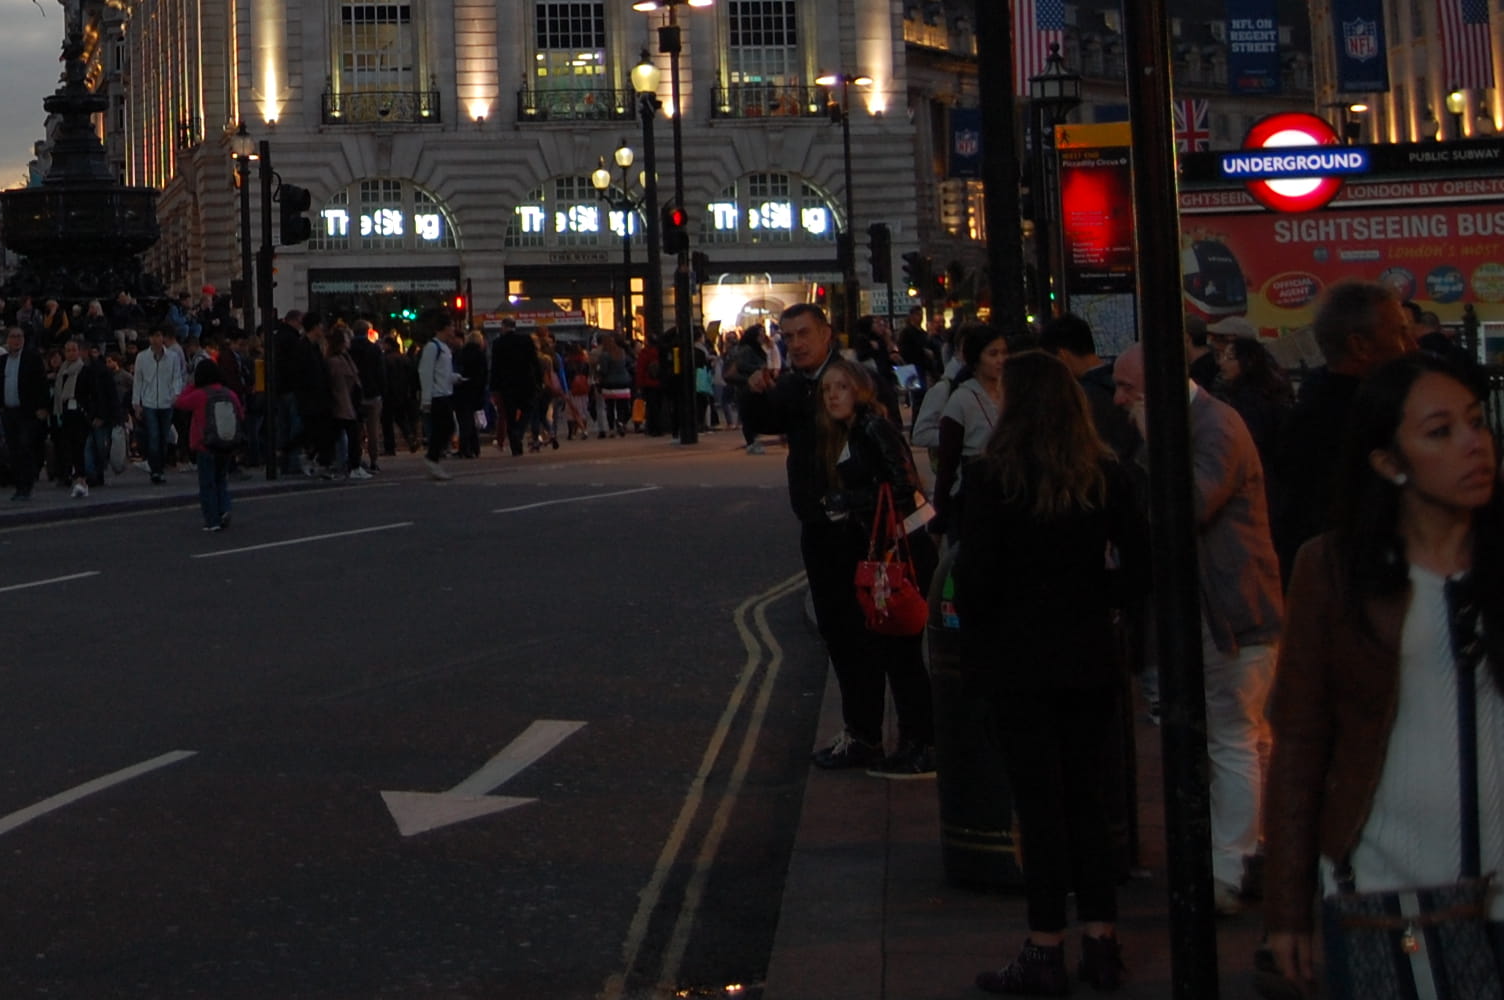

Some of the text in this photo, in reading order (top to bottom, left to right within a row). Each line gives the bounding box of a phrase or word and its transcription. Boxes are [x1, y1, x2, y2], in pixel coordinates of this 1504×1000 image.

[1231, 18, 1273, 30] NFL ON
[1230, 30, 1277, 42] REGENT
[1231, 42, 1277, 53] STREET
[1350, 37, 1375, 52] NFL
[1222, 152, 1363, 174] UNDERGROUND
[1408, 148, 1500, 163] PUBLIC SUBWAY
[1347, 182, 1415, 200] LONDON
[1418, 182, 1439, 195] BY
[373, 207, 440, 240] Stng
[568, 204, 635, 237] Stng
[1274, 213, 1449, 244] SIGHTSEEING
[1272, 278, 1313, 290] OFFICIAL
[1279, 287, 1311, 298] AGENT
